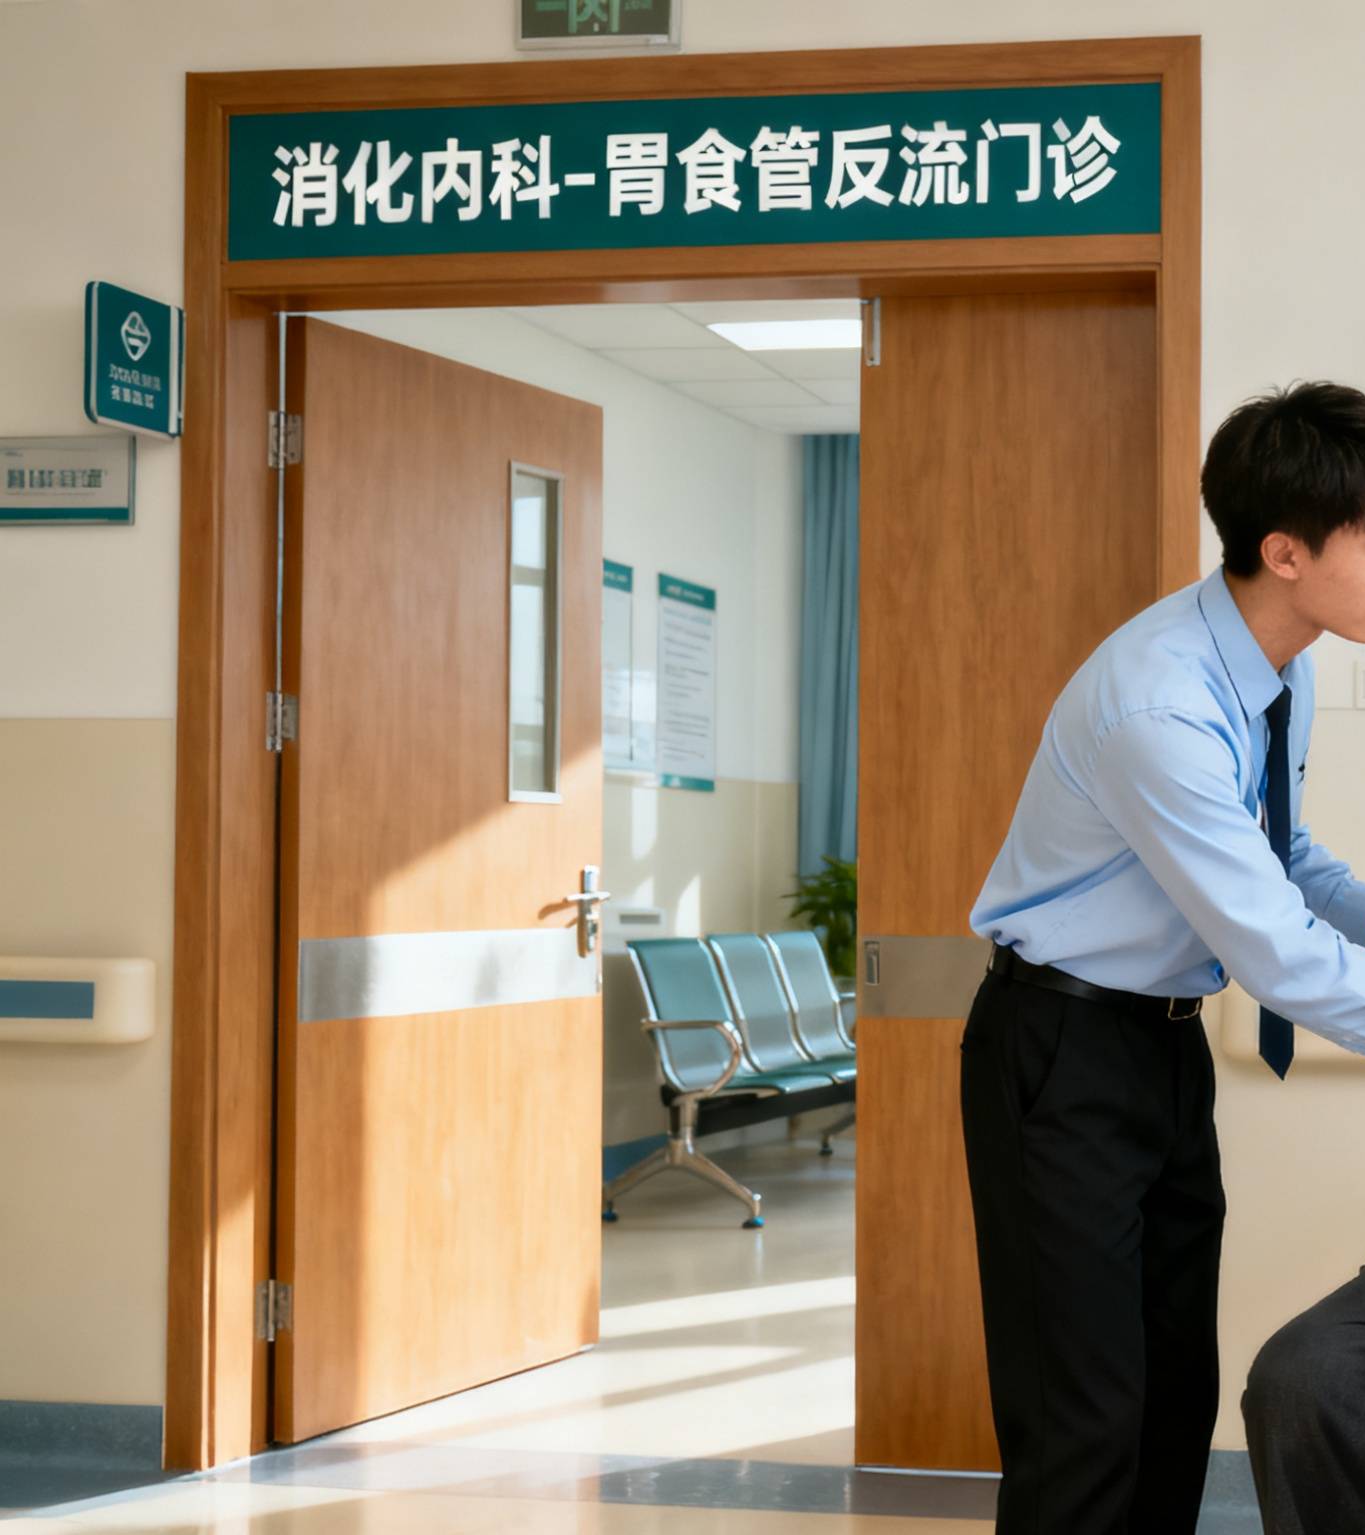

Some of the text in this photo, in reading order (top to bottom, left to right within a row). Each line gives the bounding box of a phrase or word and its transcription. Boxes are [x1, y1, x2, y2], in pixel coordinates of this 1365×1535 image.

[272, 115, 1121, 227] 消化内科-胃食管反流门诊
